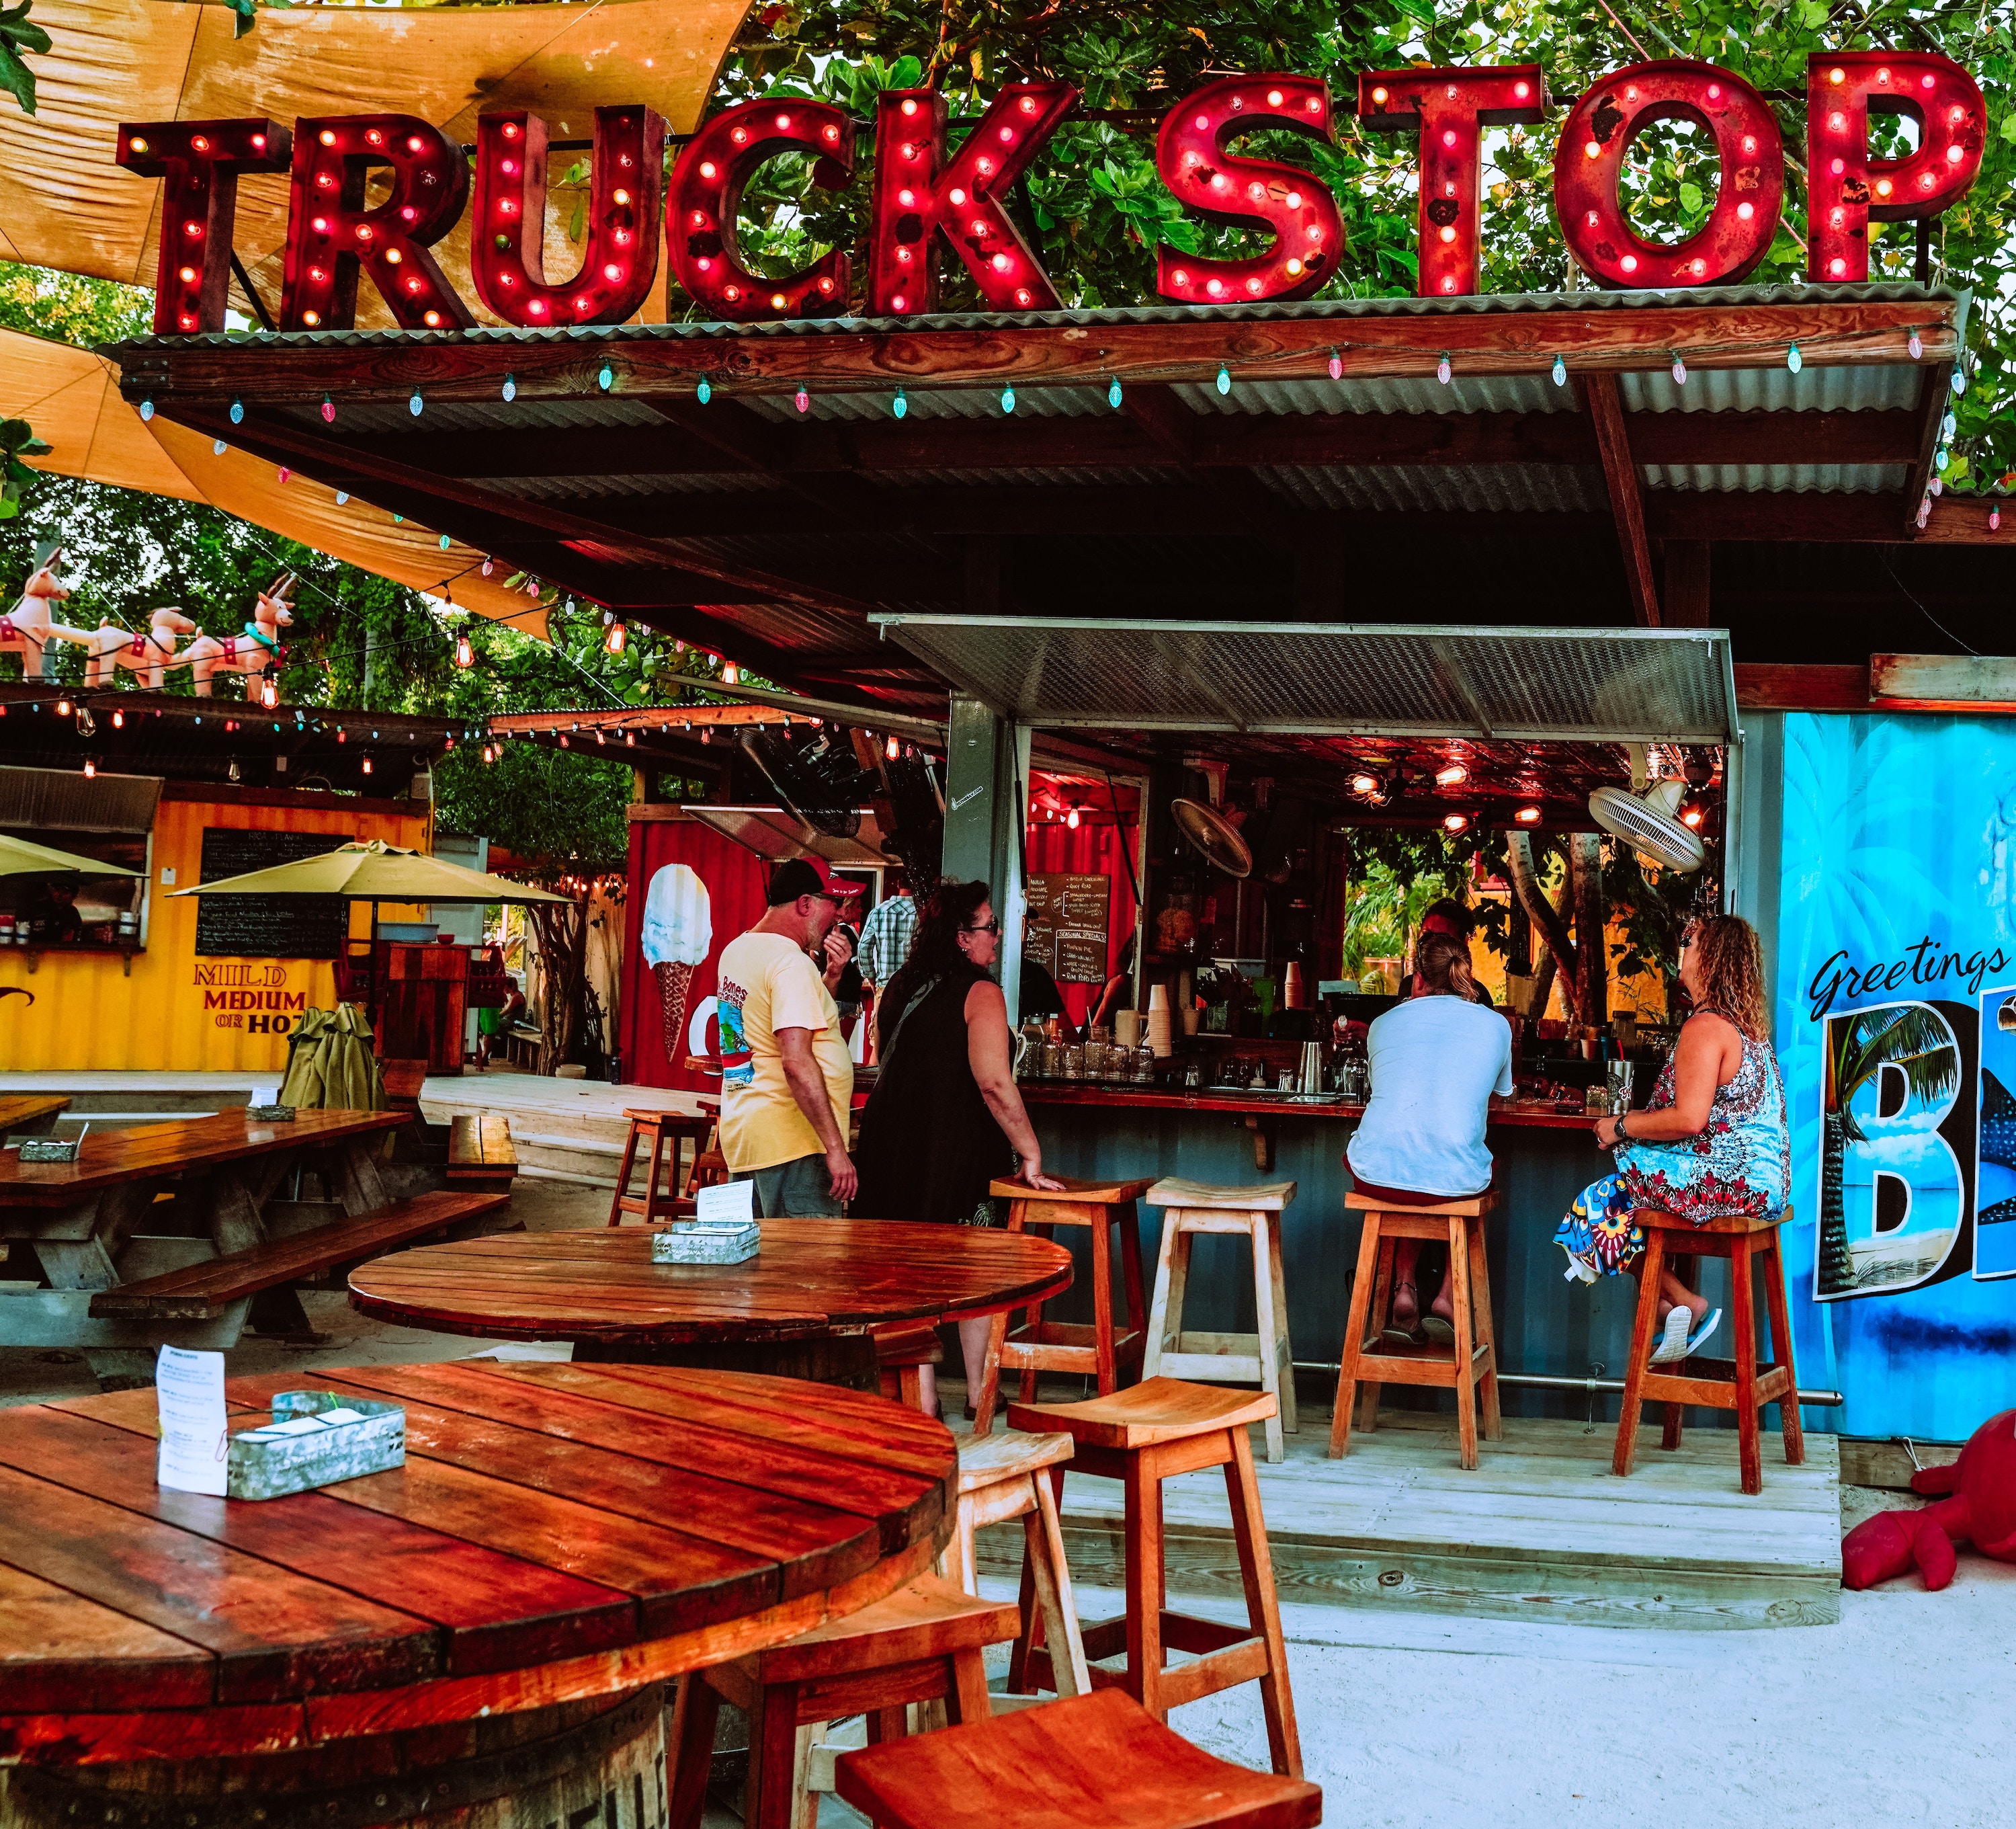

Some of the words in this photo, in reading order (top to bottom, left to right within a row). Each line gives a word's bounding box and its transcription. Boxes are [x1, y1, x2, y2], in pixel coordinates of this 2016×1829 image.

[118, 79, 1076, 335] TRUCK
[1157, 51, 1988, 304] STOP
[193, 964, 287, 987] MILD
[1810, 935, 2012, 1022] Greetings
[722, 975, 748, 1001] Bones
[204, 990, 306, 1011] MEDIUM
[215, 1014, 243, 1028] OR
[248, 1014, 303, 1034] HO
